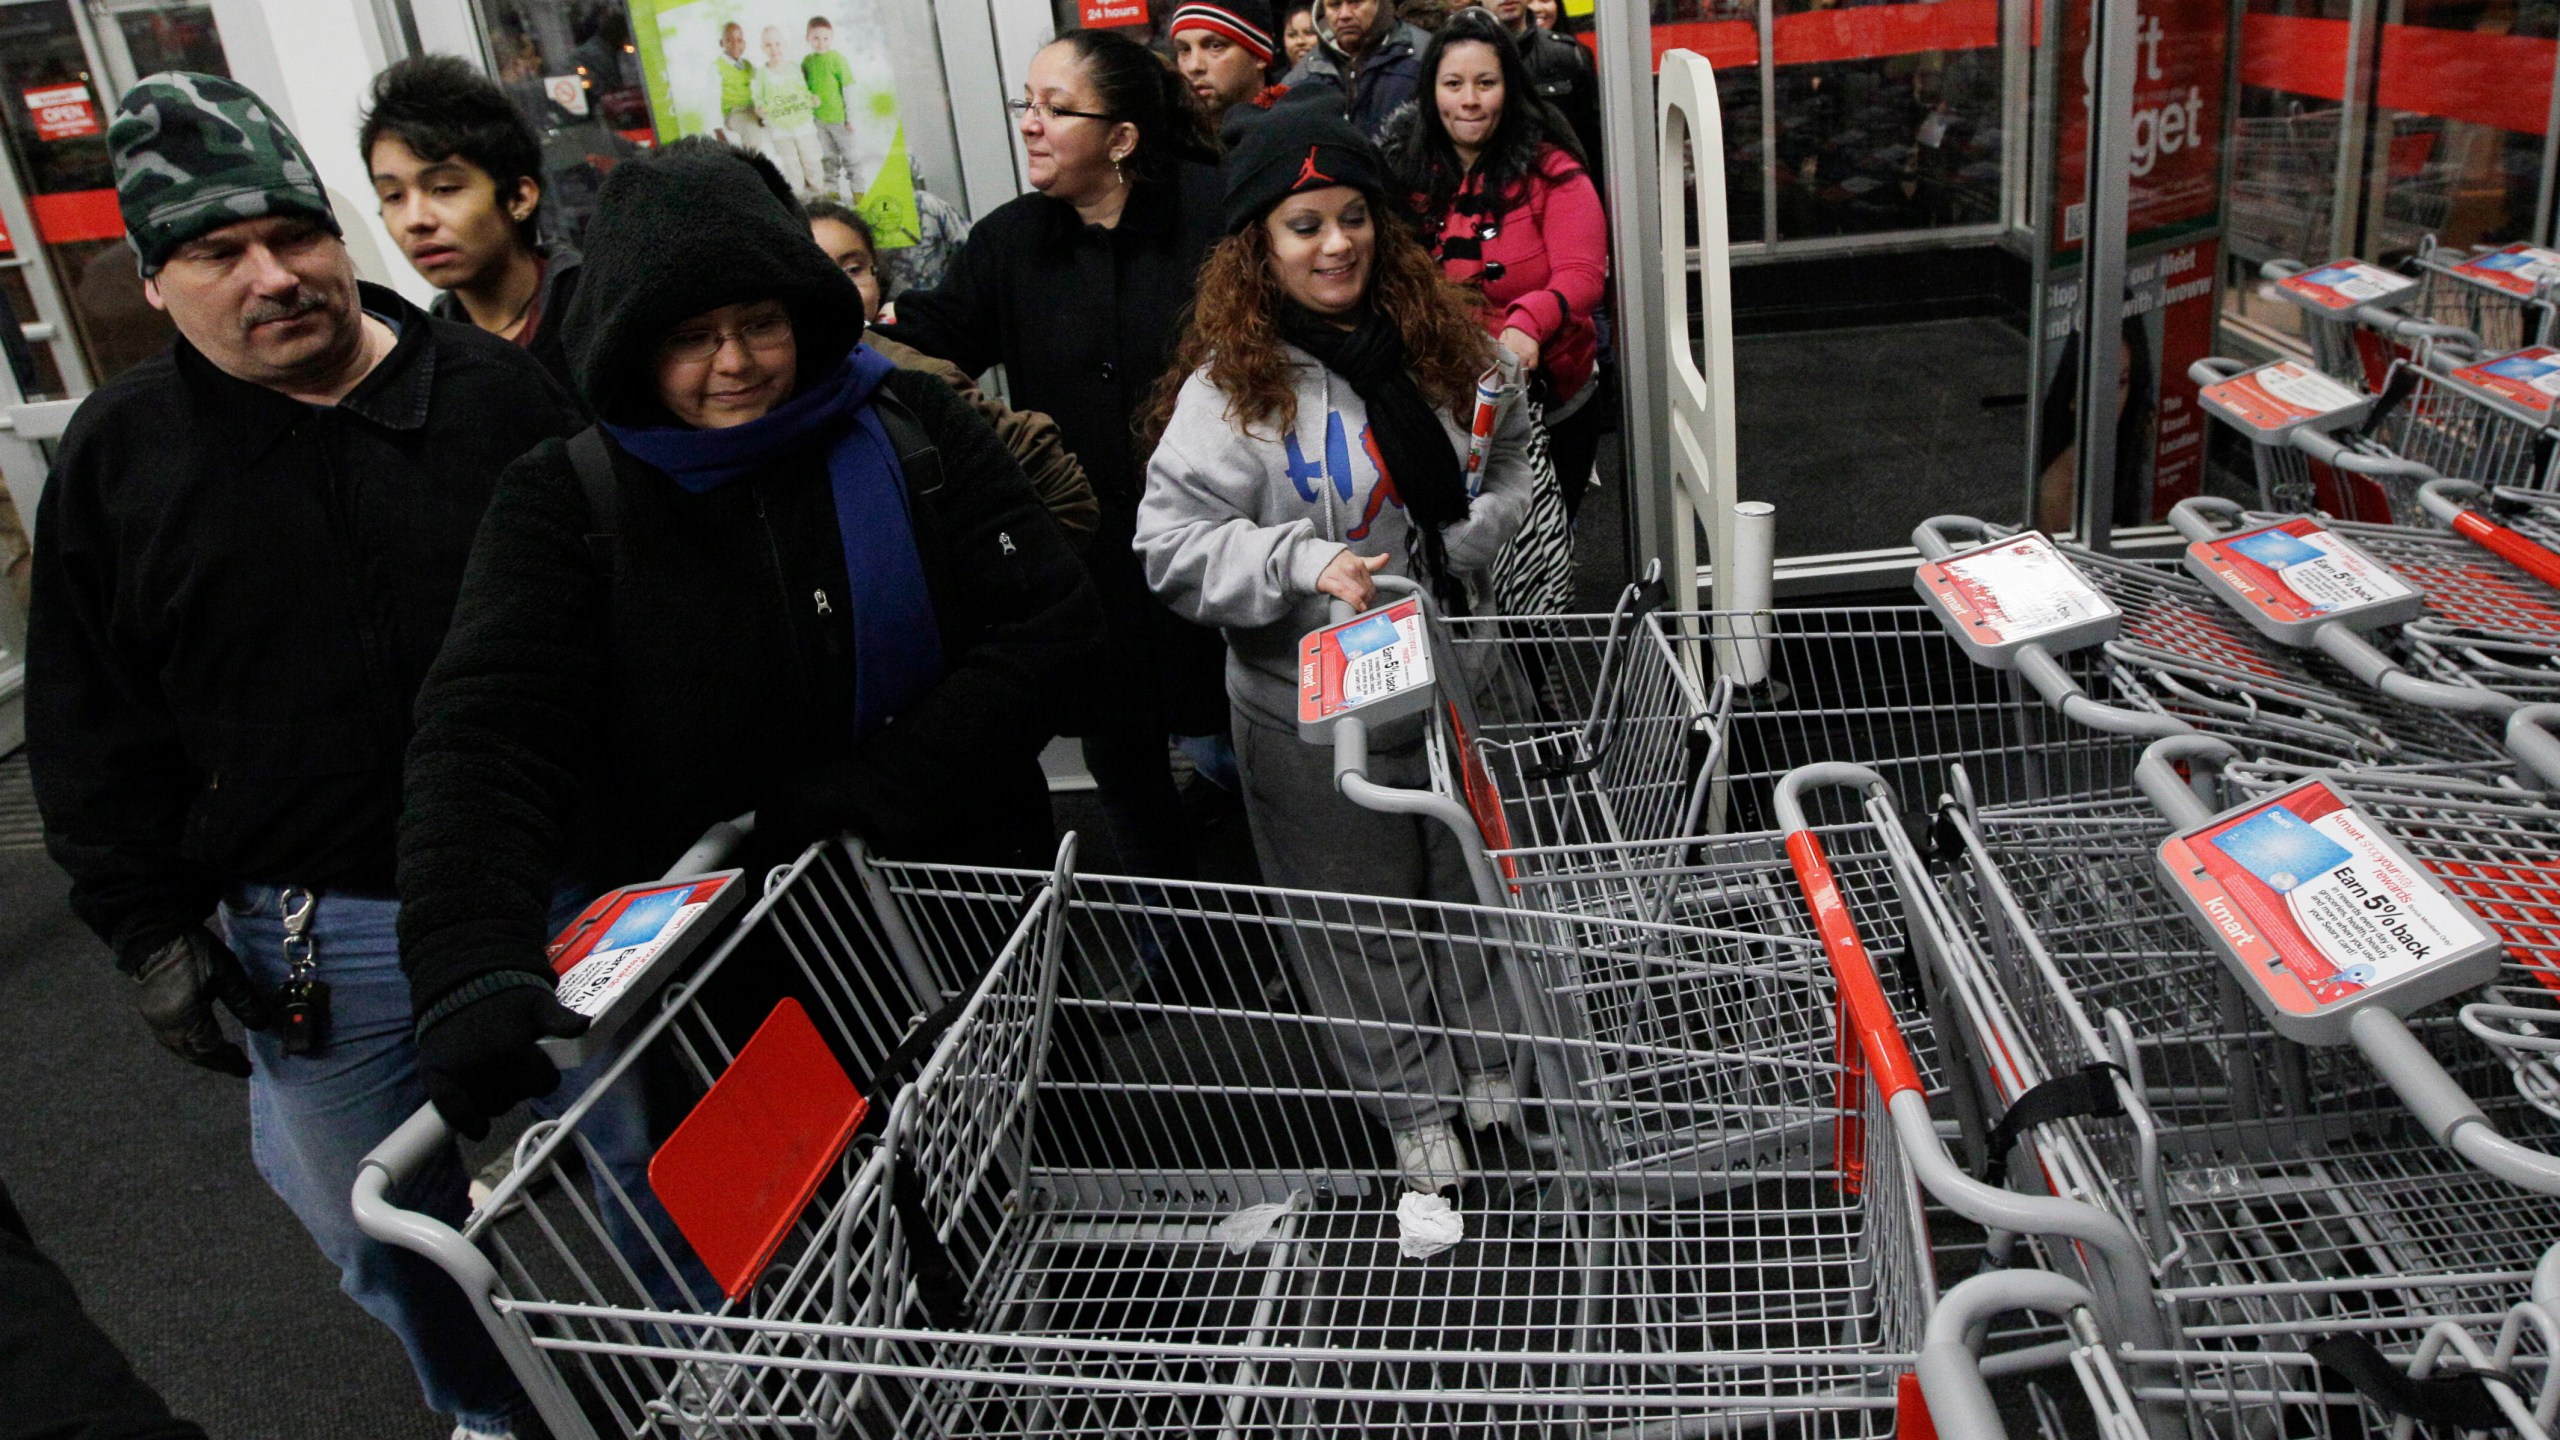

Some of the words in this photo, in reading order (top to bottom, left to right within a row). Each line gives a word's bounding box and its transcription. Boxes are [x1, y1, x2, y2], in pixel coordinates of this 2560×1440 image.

[1087, 8, 1103, 21] 24
[1104, 6, 1139, 18] hours
[2220, 569, 2256, 595] kmart
[1940, 591, 1970, 617] kmart
[1382, 646, 1395, 663] Earn
[1303, 662, 1317, 690] kmart
[2333, 813, 2366, 842] kmart
[2372, 869, 2414, 905] rewards
[2204, 896, 2256, 948] kmart
[2308, 908, 2324, 923] your
[2321, 920, 2342, 941] Sears
[2318, 889, 2346, 919] groceries,
[2347, 916, 2367, 939] health,
[2364, 934, 2389, 960] beauty
[2333, 866, 2369, 899] Earn
[2363, 894, 2405, 928] 5%
[2390, 923, 2431, 960] back
[2337, 891, 2362, 917] rewards
[2359, 915, 2377, 934] every
[2375, 931, 2390, 945] day
[2386, 942, 2398, 953] on
[2310, 894, 2324, 907] and
[2321, 905, 2338, 922] more
[2336, 920, 2354, 938] when
[2350, 935, 2366, 952] you
[2361, 949, 2377, 962] use
[601, 947, 638, 976] Earn
[575, 976, 612, 1003] 5%
